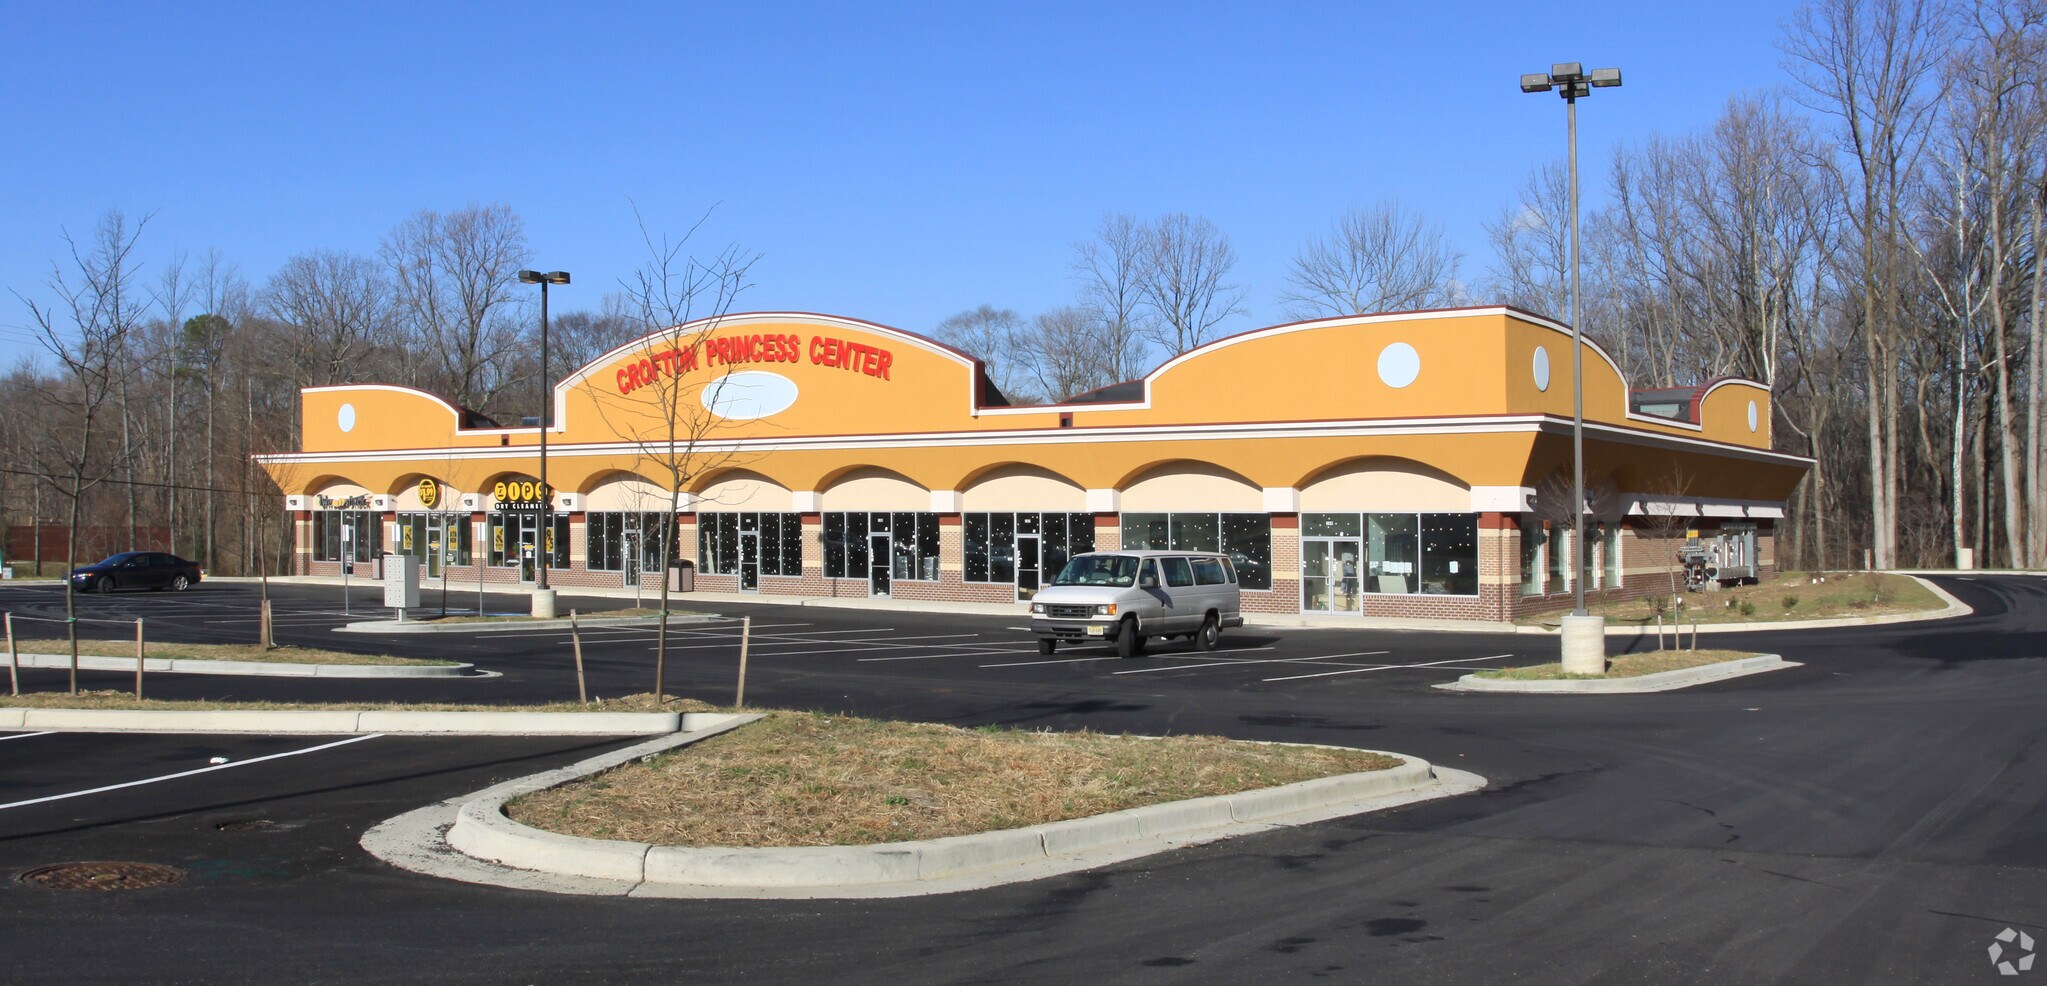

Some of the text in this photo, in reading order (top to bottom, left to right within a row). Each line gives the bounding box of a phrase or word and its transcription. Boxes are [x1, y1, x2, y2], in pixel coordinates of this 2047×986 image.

[616, 333, 893, 395] CROFTON PRINCESS CENTER
